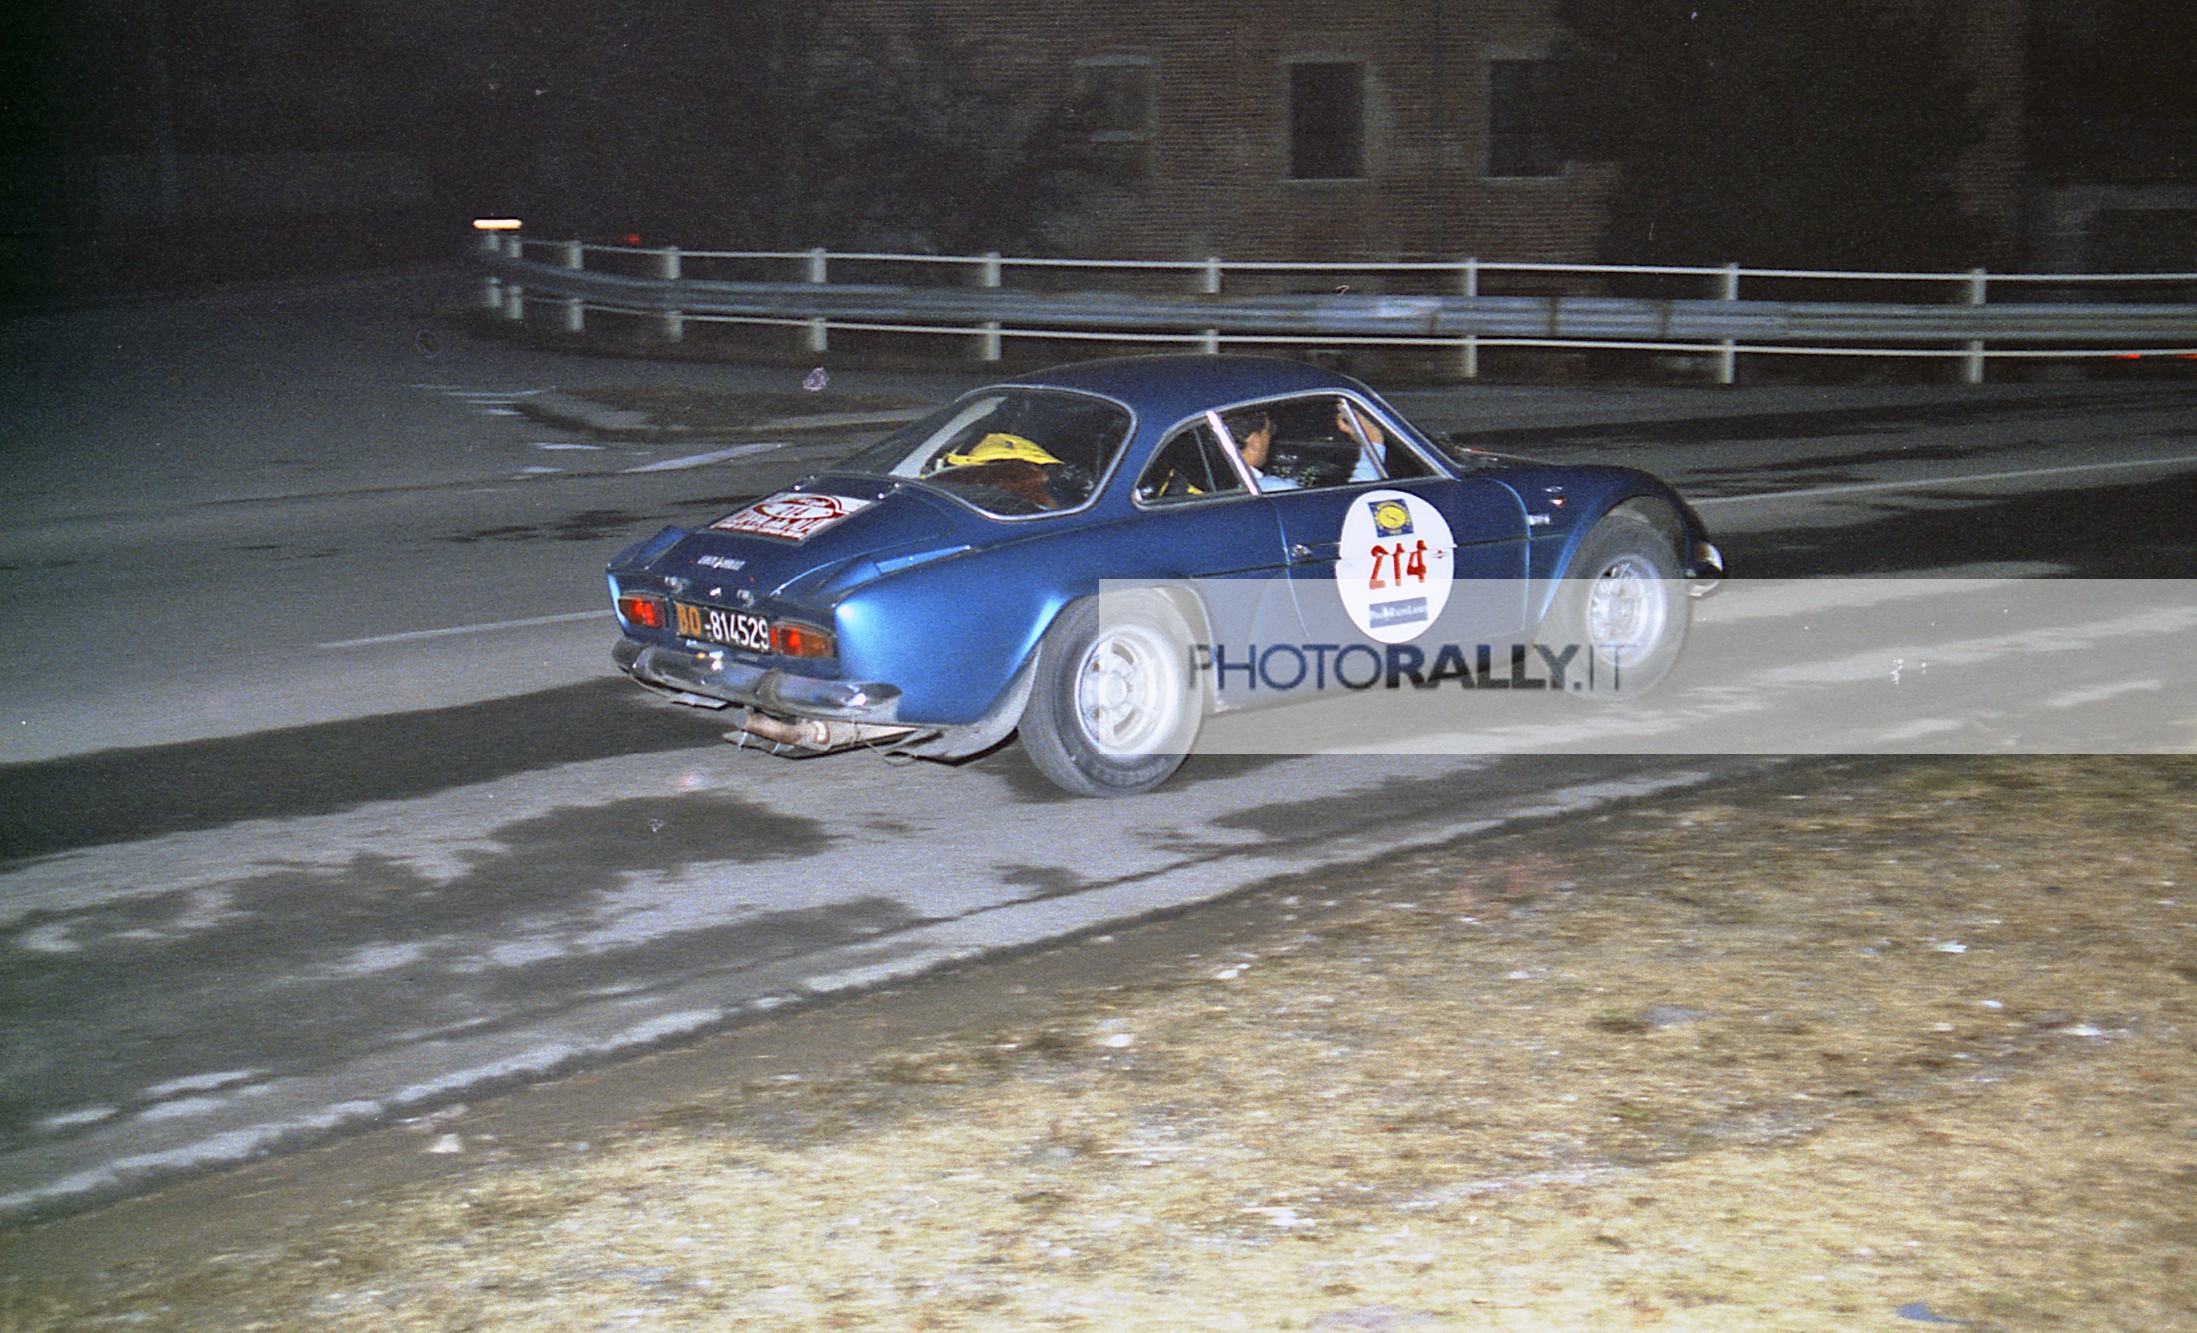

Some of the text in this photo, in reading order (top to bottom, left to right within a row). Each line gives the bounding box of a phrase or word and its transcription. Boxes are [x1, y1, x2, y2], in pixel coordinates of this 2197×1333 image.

[1369, 540, 1428, 590] 214
[677, 604, 770, 650] BO 814529
